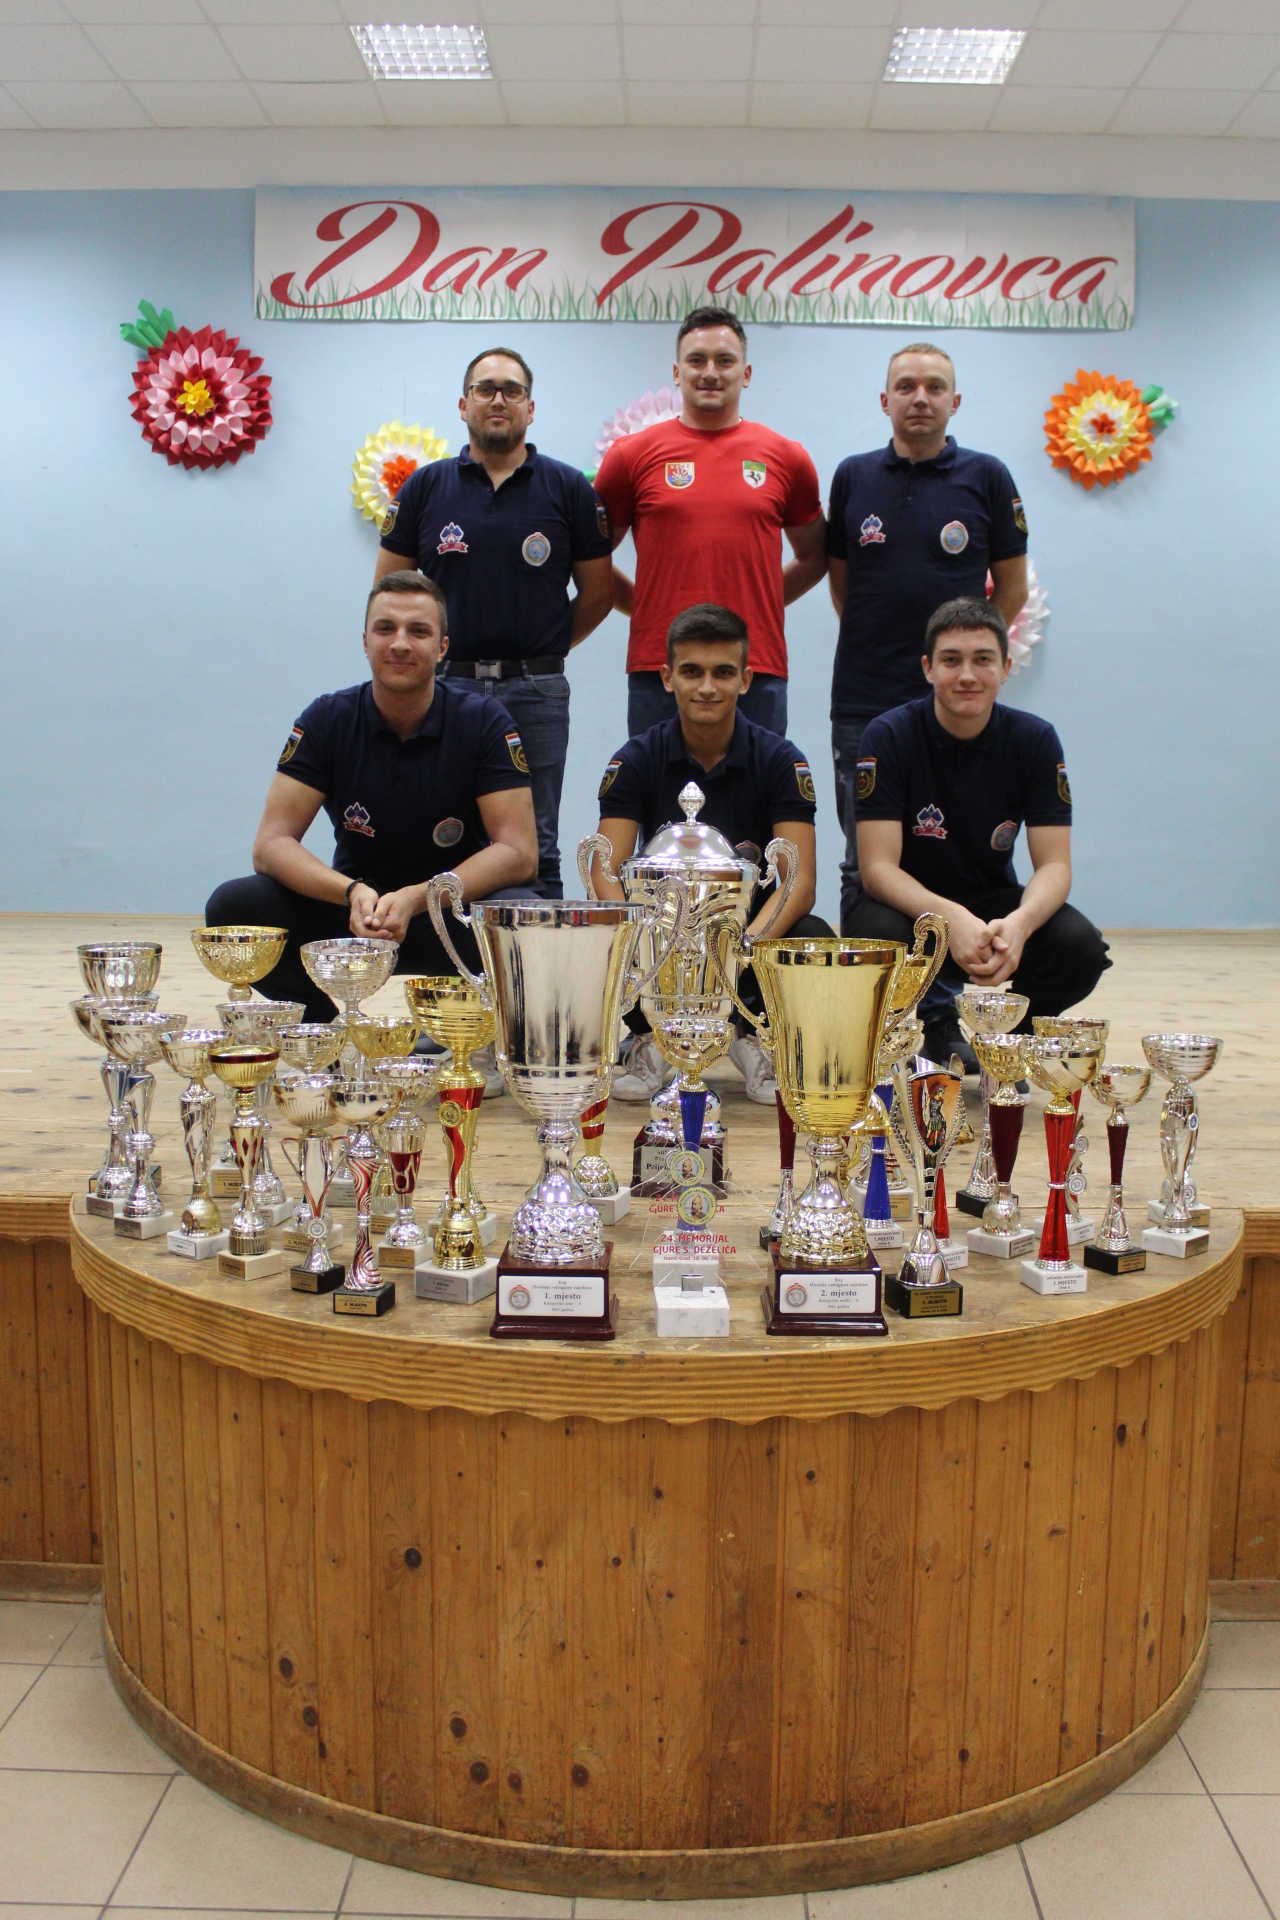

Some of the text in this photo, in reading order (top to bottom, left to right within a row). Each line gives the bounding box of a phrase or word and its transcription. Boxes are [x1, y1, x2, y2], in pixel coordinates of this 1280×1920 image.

[269, 200, 1118, 309] Dan Palinovca
[678, 1234, 729, 1244] MEMORIJAL
[653, 1246, 680, 1254] GJURE
[683, 1246, 691, 1254] S.
